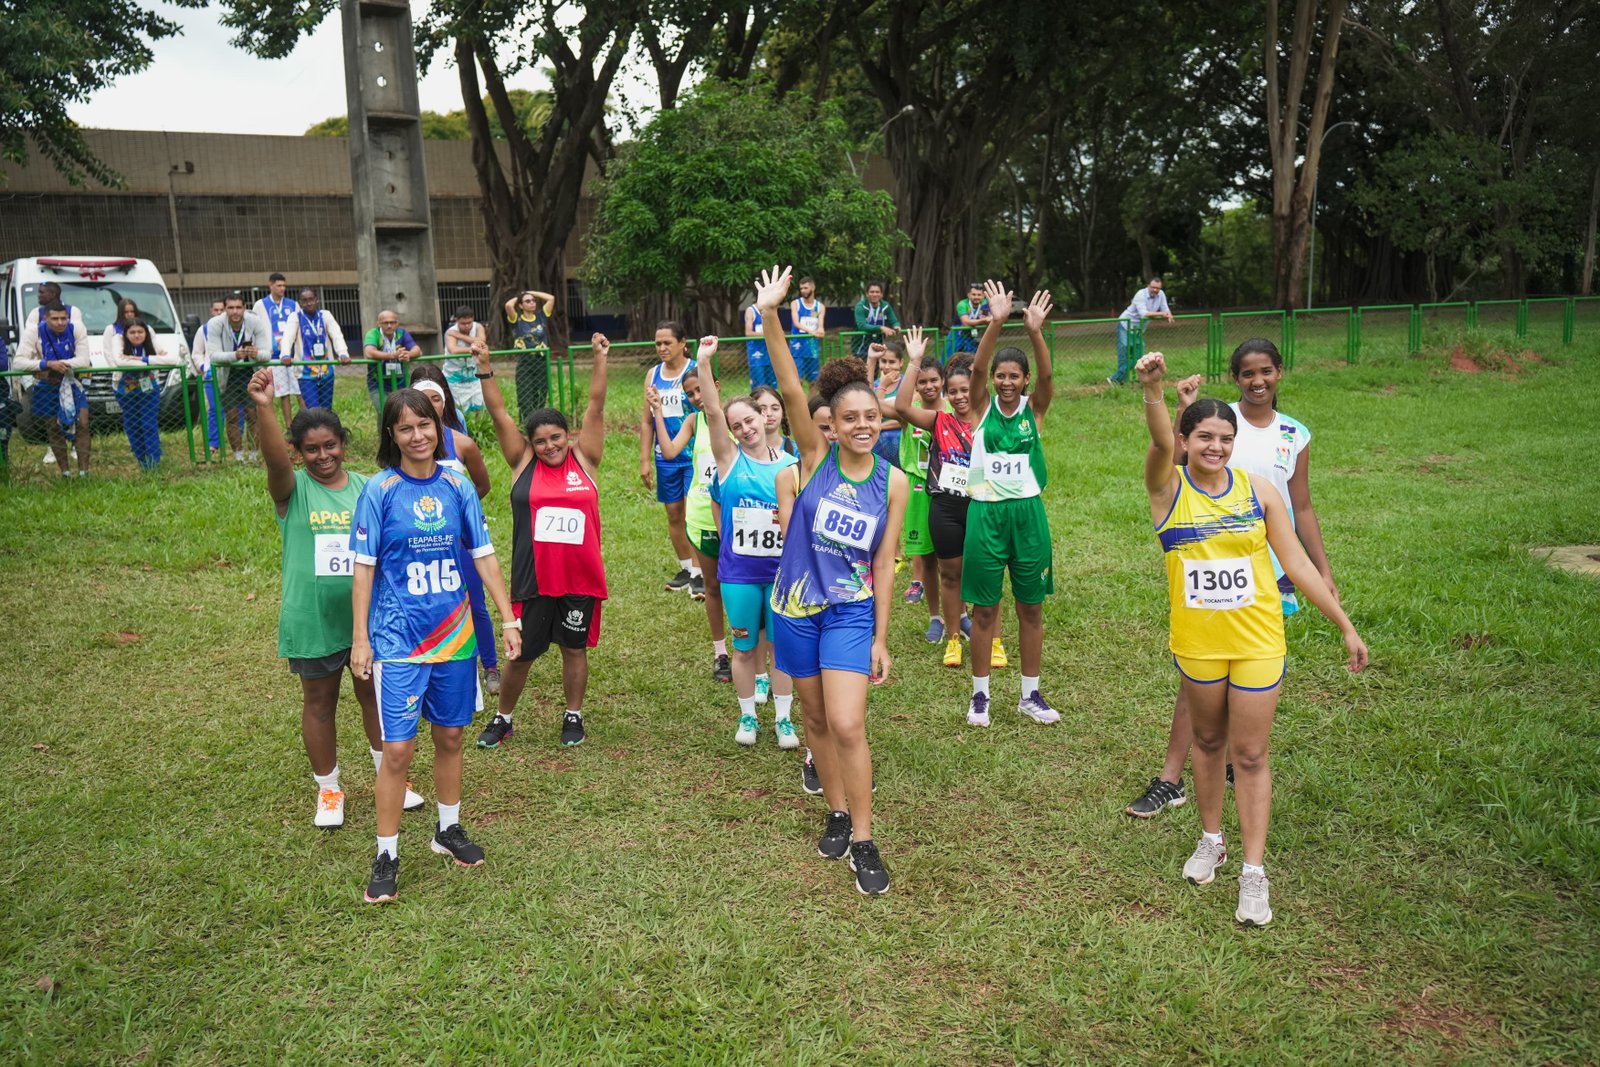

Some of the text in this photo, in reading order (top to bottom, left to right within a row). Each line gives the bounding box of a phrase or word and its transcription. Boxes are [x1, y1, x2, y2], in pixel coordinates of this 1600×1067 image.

[991, 461, 1022, 475] 911
[309, 510, 351, 525] APAE
[544, 515, 579, 533] 710
[824, 509, 868, 542] 859
[735, 528, 784, 550] 1185
[329, 556, 351, 573] 61
[406, 558, 462, 596] 815
[1188, 568, 1248, 591] 1306
